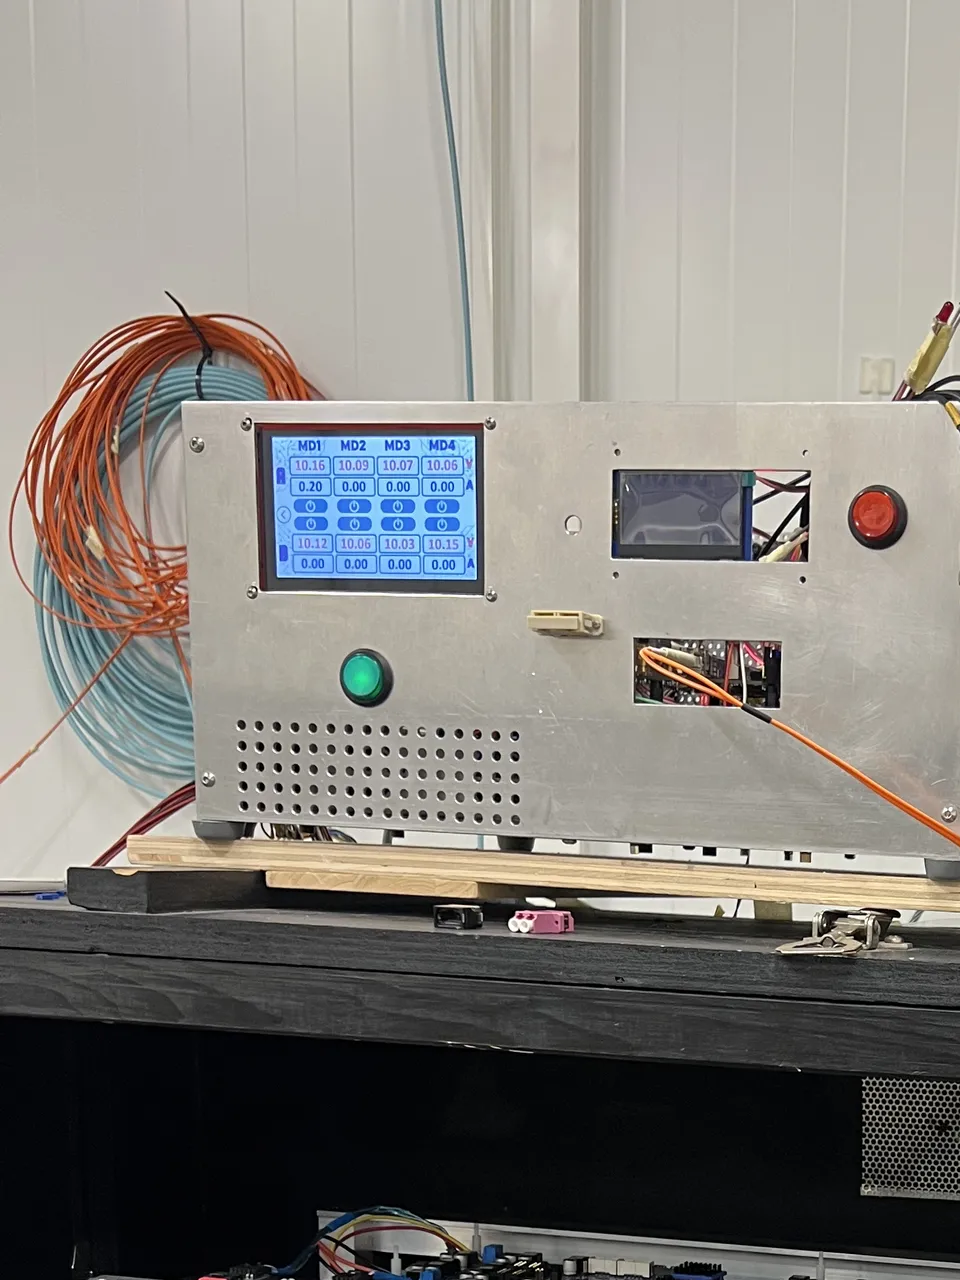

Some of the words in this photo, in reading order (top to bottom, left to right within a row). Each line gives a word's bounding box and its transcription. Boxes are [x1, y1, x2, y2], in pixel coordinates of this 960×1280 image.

[298, 440, 321, 451] MD1
[341, 440, 366, 451] MD2
[385, 439, 411, 451] MD3
[429, 439, 456, 451] MD4
[295, 459, 325, 471] 10.16
[338, 459, 369, 471] 10.09
[383, 459, 413, 471] 10.07
[427, 459, 458, 471] 10.06
[298, 480, 323, 492] 0.20
[342, 480, 366, 492] 0.00
[386, 480, 410, 492] 0.00
[430, 481, 455, 492] 0.00
[298, 537, 328, 549] 10.12
[341, 538, 371, 549] 10.06
[385, 538, 415, 550] 10.03
[428, 539, 459, 550] 10.15
[301, 558, 325, 569] 0.00
[344, 558, 368, 569] 0.00
[388, 559, 412, 570] 0.00
[431, 559, 456, 570] 0.00
